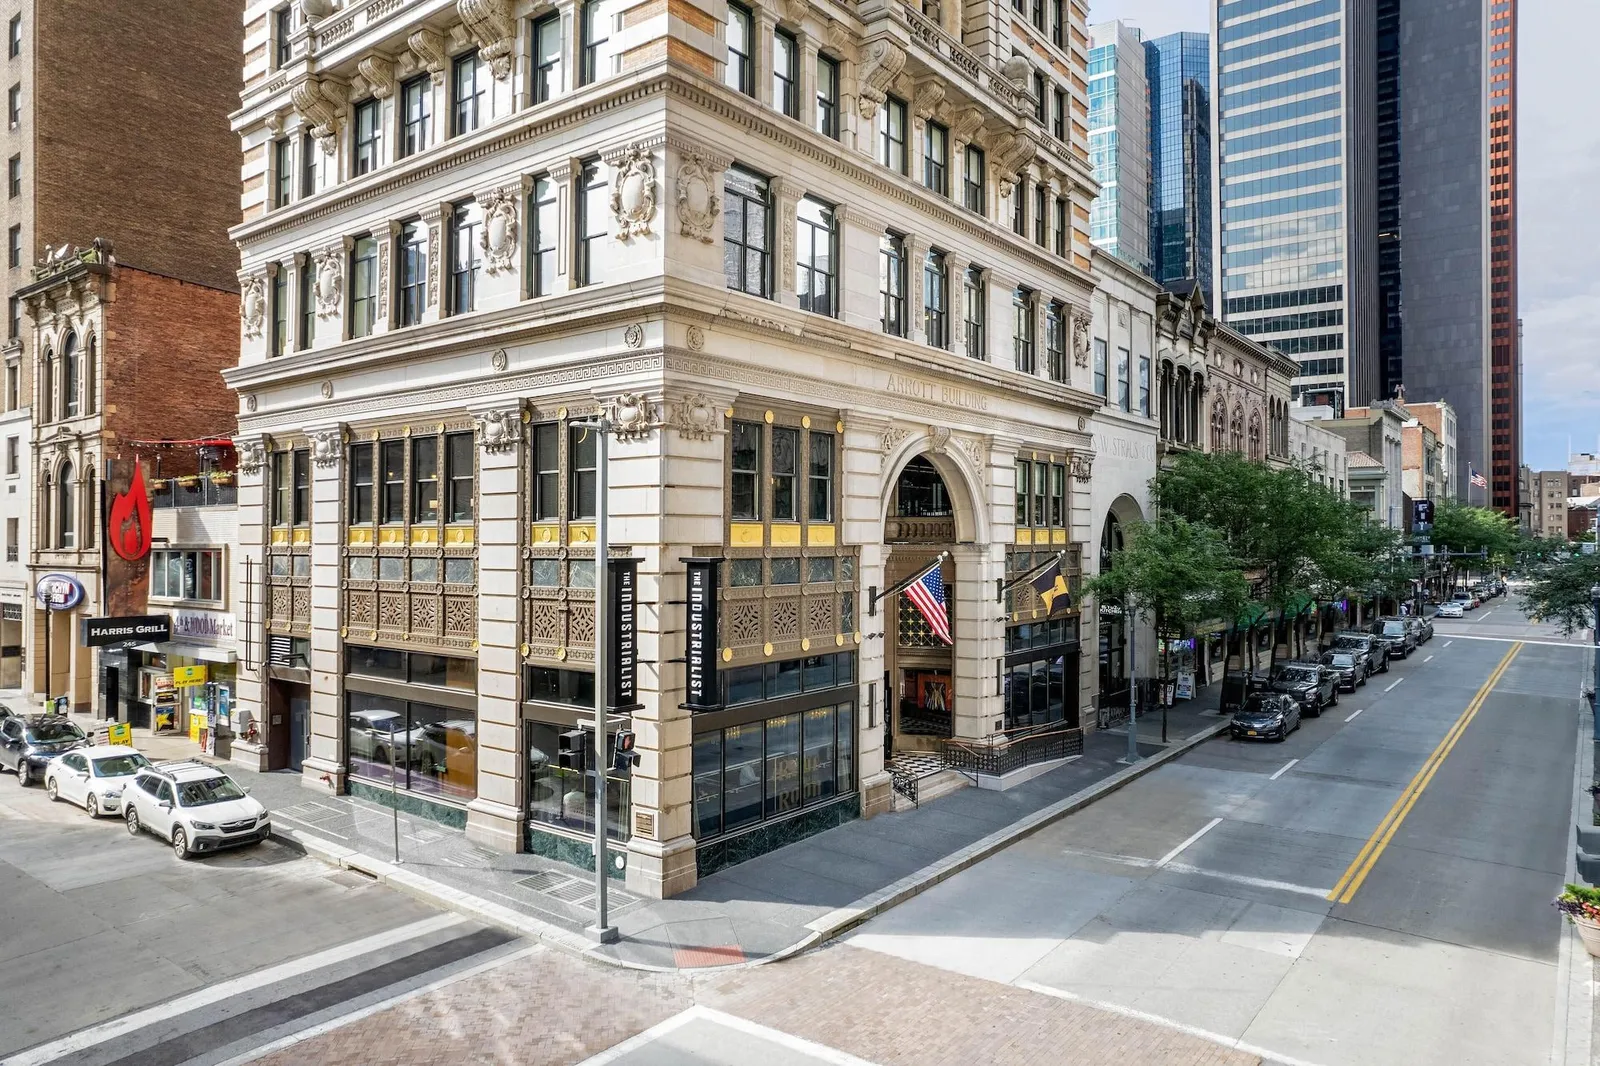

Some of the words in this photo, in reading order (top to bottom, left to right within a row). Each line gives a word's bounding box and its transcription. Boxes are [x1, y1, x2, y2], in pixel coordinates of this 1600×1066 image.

[887, 373, 936, 399] ARROTT
[941, 385, 988, 410] BUILDING
[623, 571, 631, 585] THE
[693, 571, 701, 585] THE
[91, 626, 134, 637] HARRIS
[136, 624, 168, 633] GRILL
[189, 616, 209, 634] WOOD
[209, 618, 234, 637] Market
[621, 587, 632, 697] INDUSTRIALIST
[691, 587, 703, 697] INDUSTRIALIST
